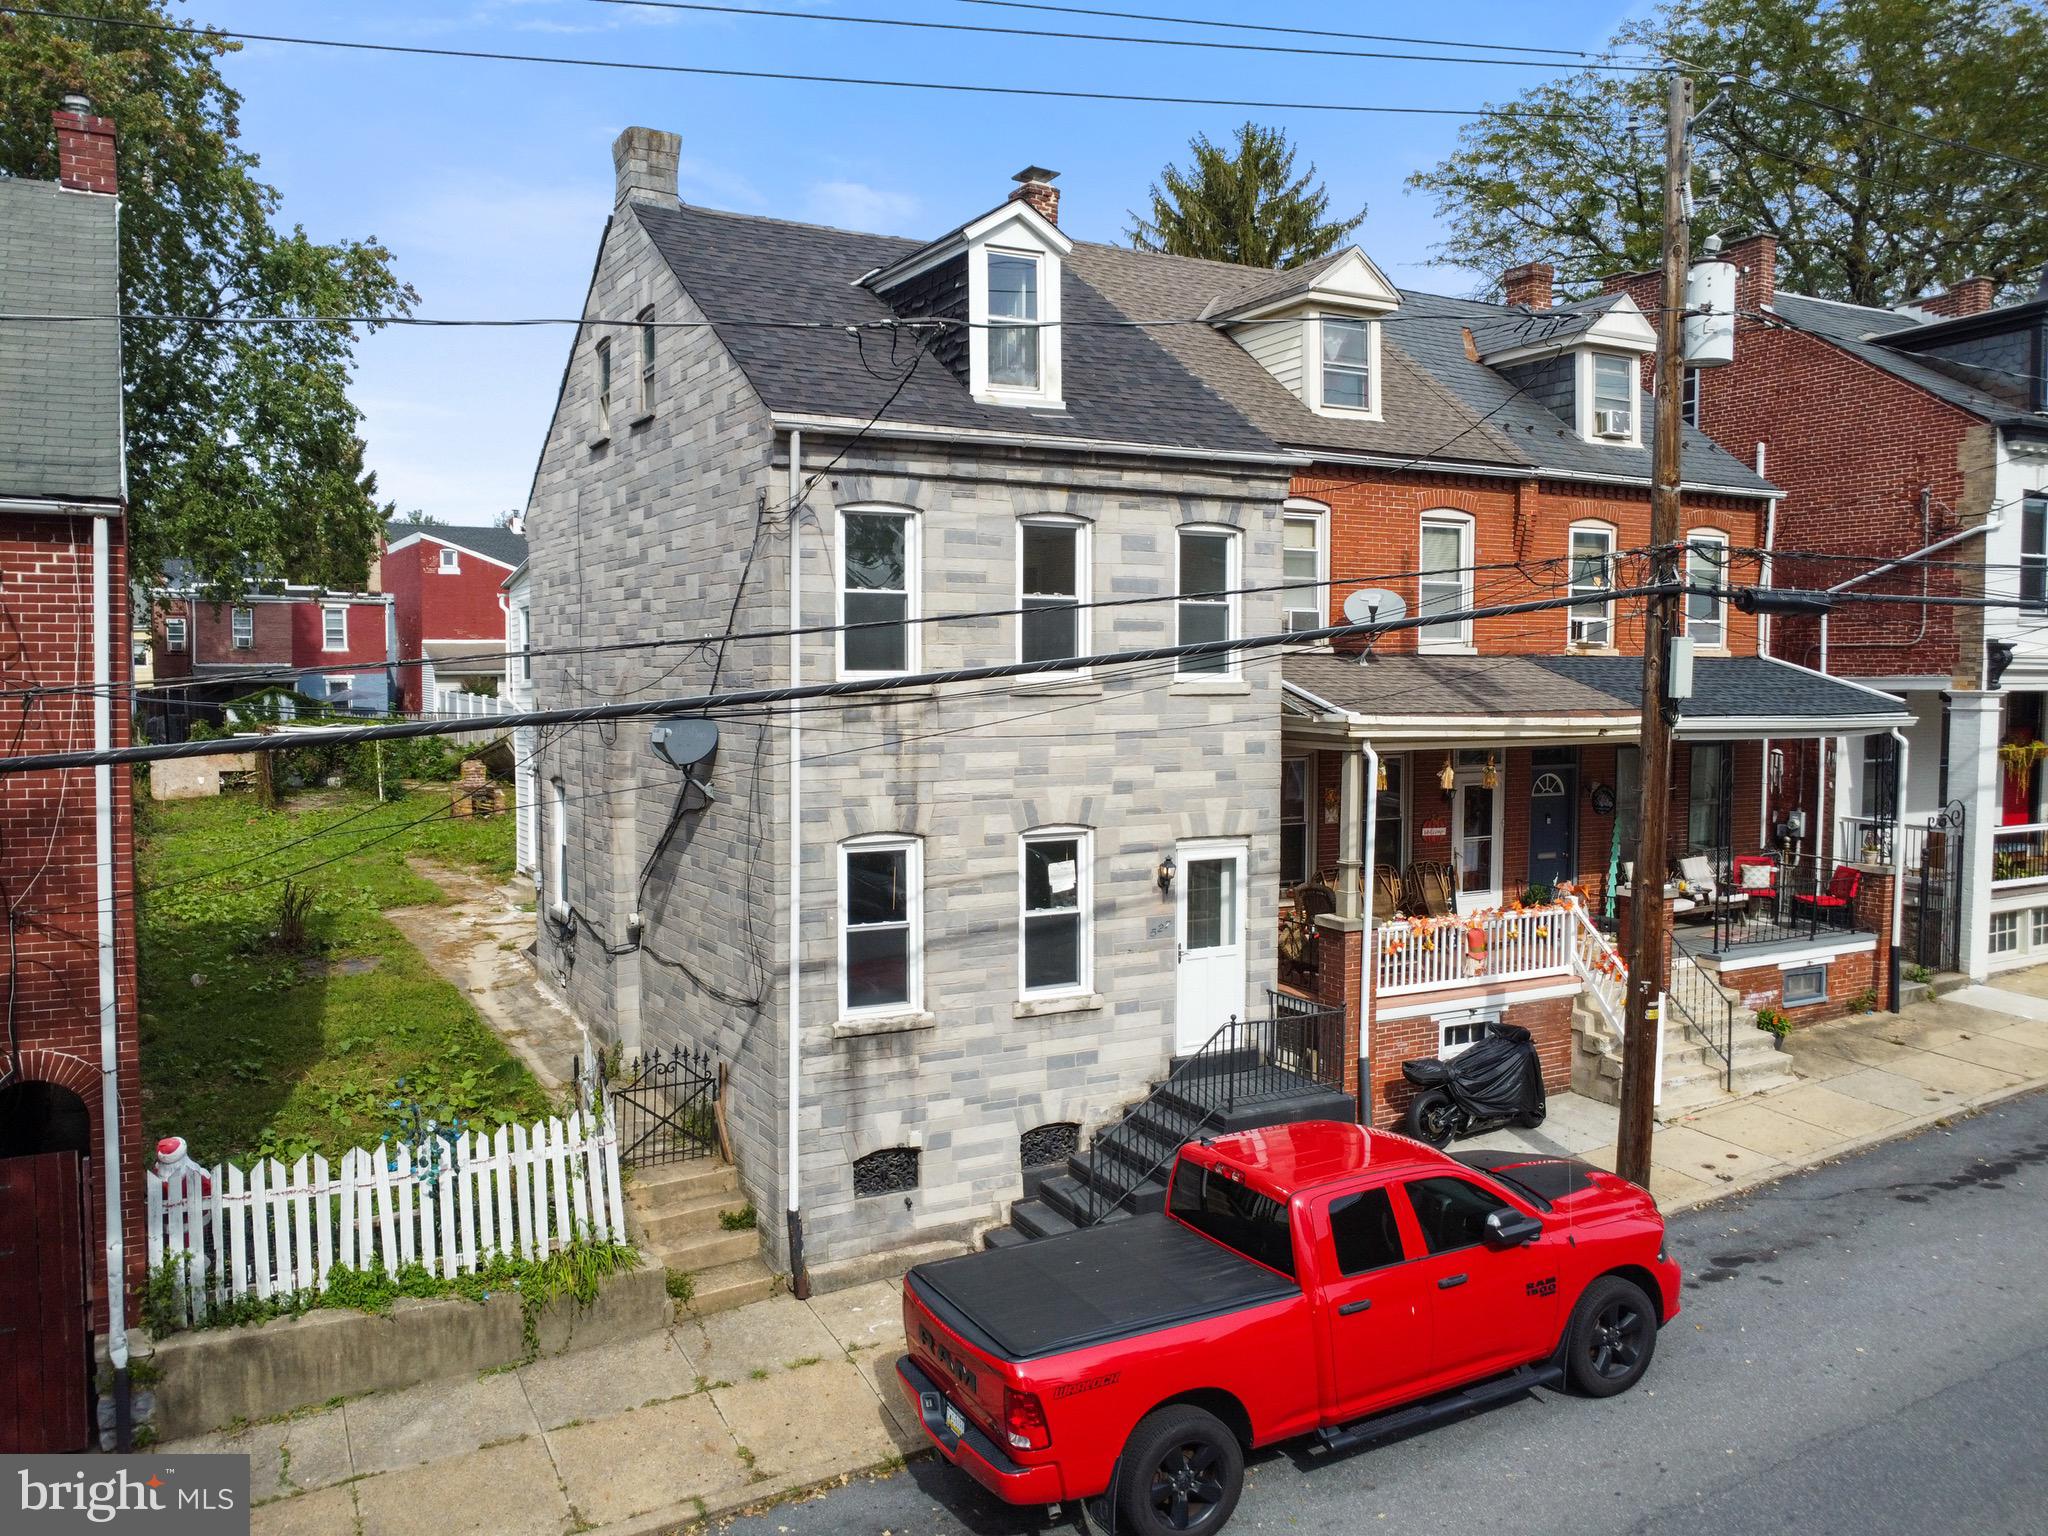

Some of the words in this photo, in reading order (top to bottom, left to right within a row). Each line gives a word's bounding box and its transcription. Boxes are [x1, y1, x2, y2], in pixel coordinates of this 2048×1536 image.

[1149, 920, 1171, 937] 527
[1526, 1276, 1556, 1289] RAM
[1526, 1284, 1556, 1296] 1500
[919, 1323, 977, 1393] RAM
